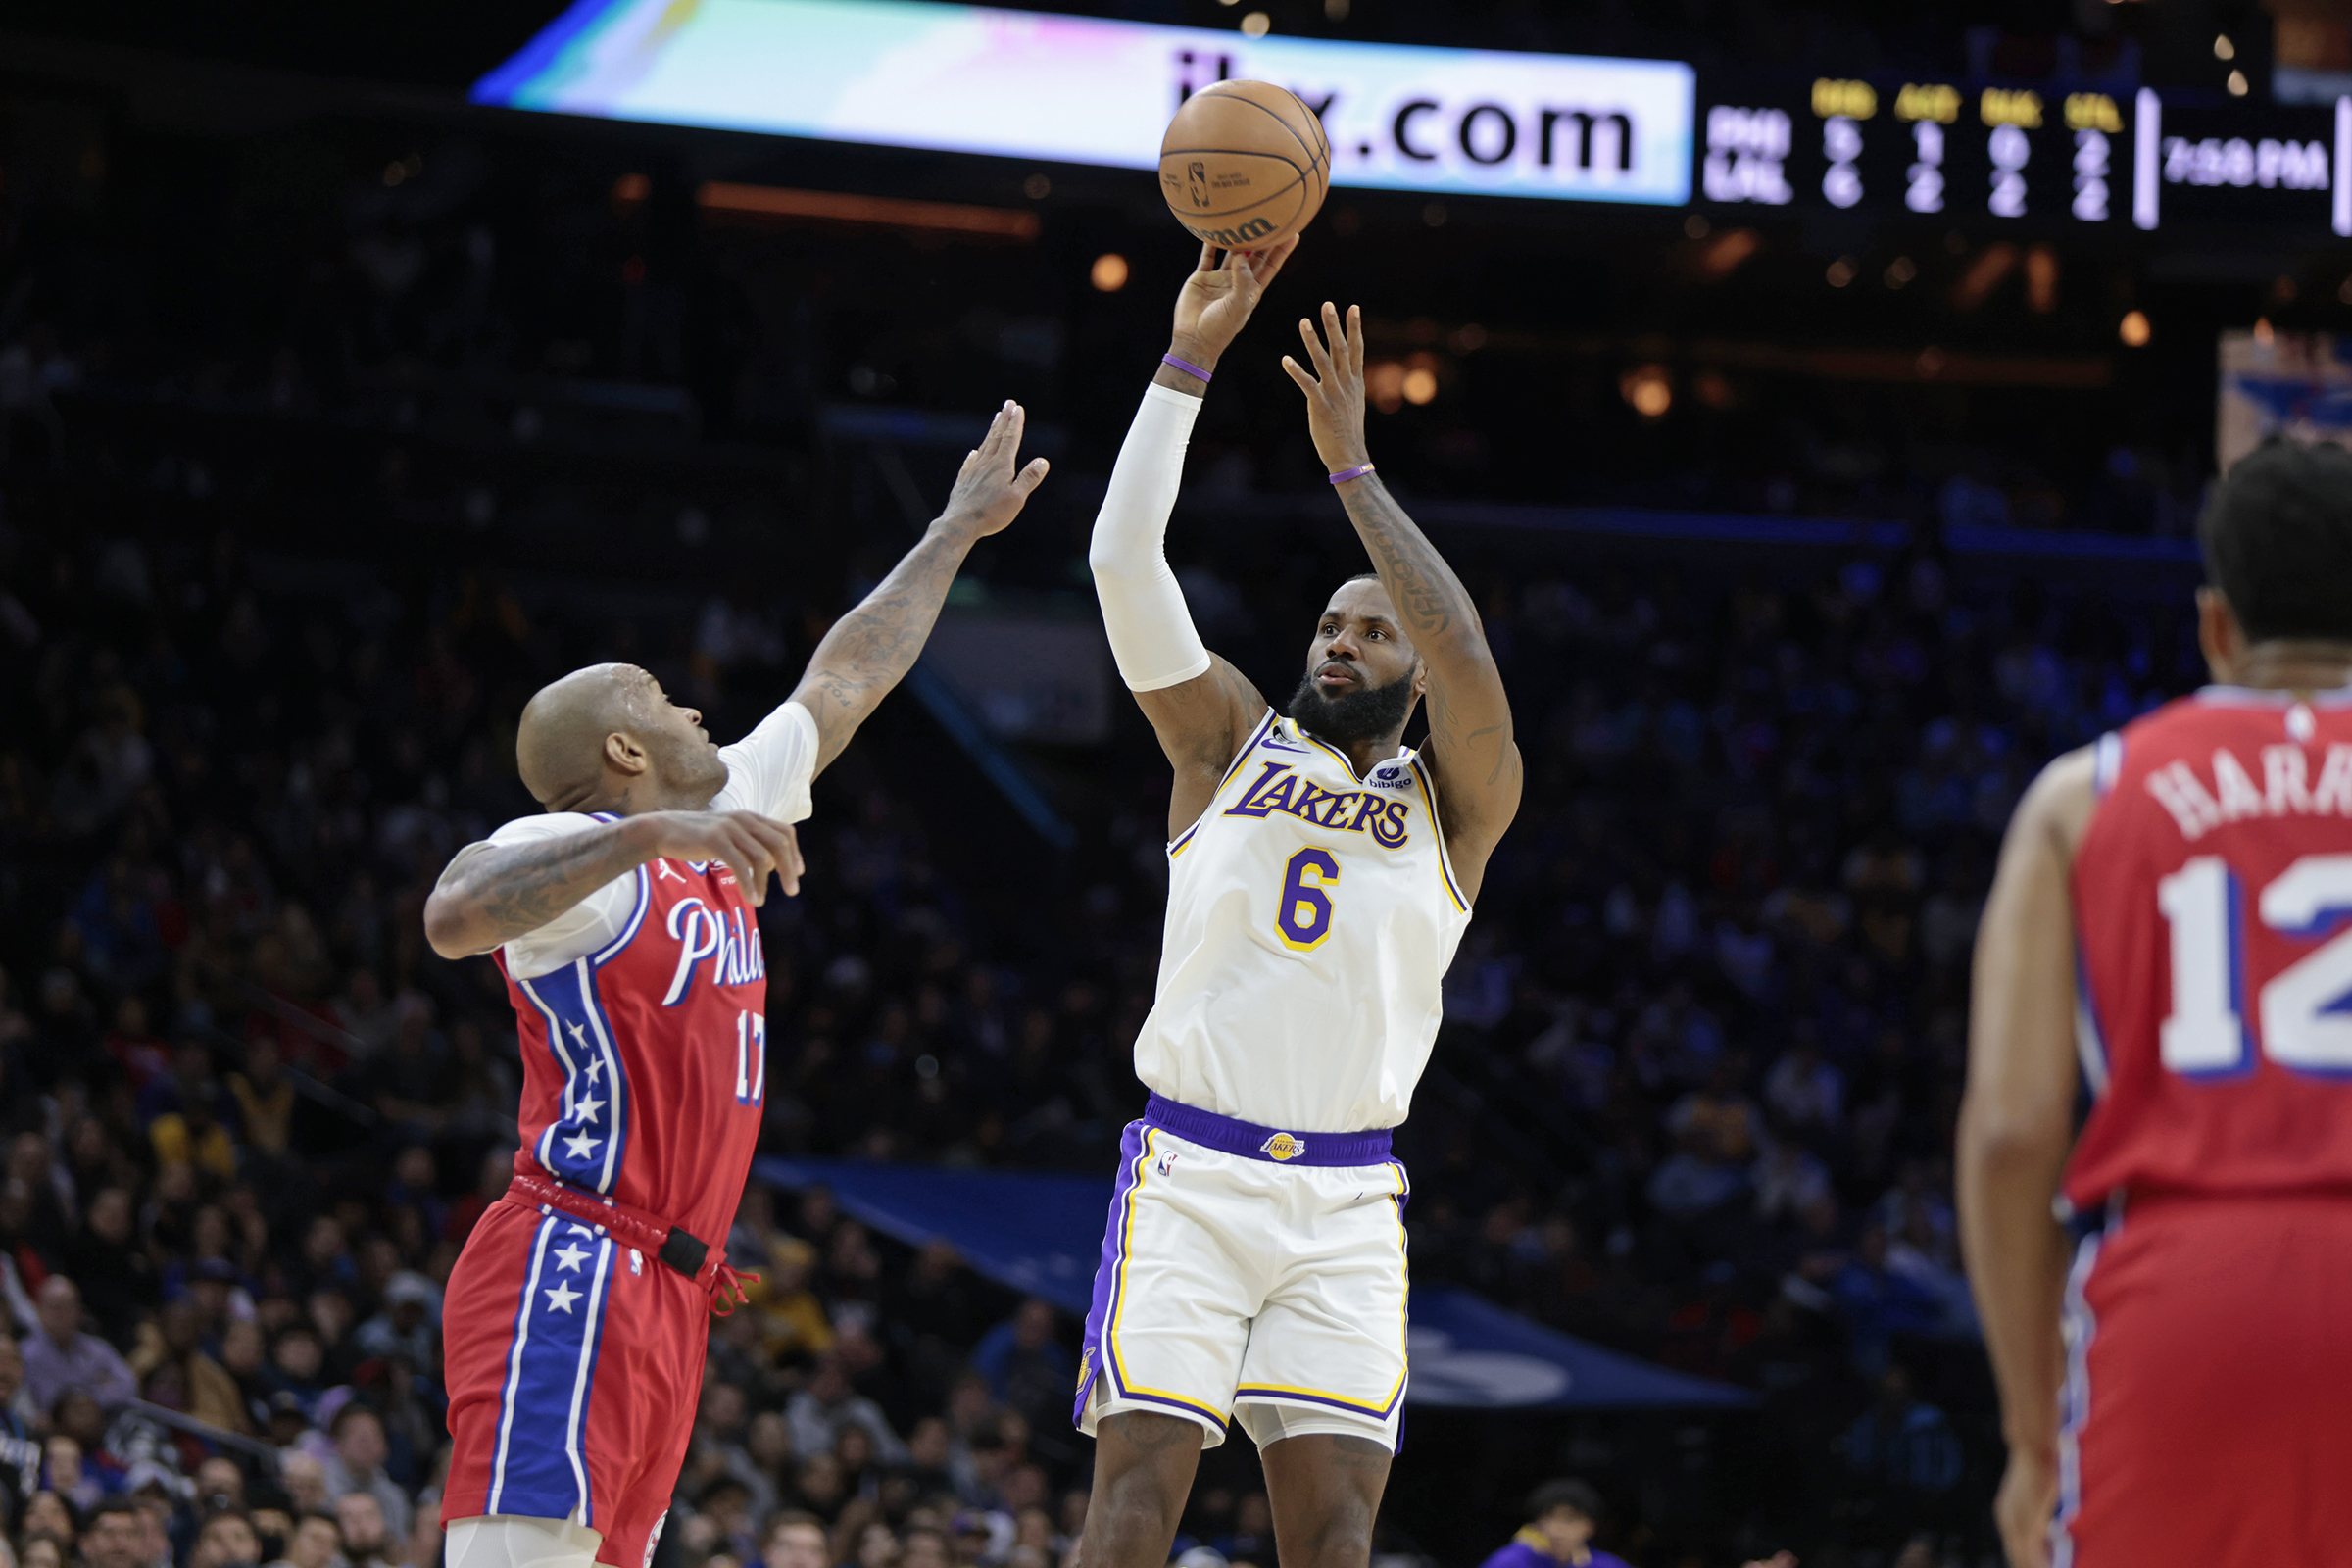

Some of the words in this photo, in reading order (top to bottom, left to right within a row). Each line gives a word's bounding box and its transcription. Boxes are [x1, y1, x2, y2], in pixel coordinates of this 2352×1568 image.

[1912, 120, 1944, 166] 1
[2073, 128, 2110, 176] 2
[1905, 163, 1945, 213] 2
[1988, 169, 2028, 217] 2
[2072, 176, 2109, 221] 2
[1179, 217, 1279, 246] Wilso
[1221, 760, 1410, 850] LAKERS
[1369, 776, 1412, 789] bibigo
[1274, 845, 1343, 953] 6
[2158, 855, 2352, 1080] 12
[736, 1009, 766, 1108] 17
[1263, 1138, 1302, 1155] LAKERS
